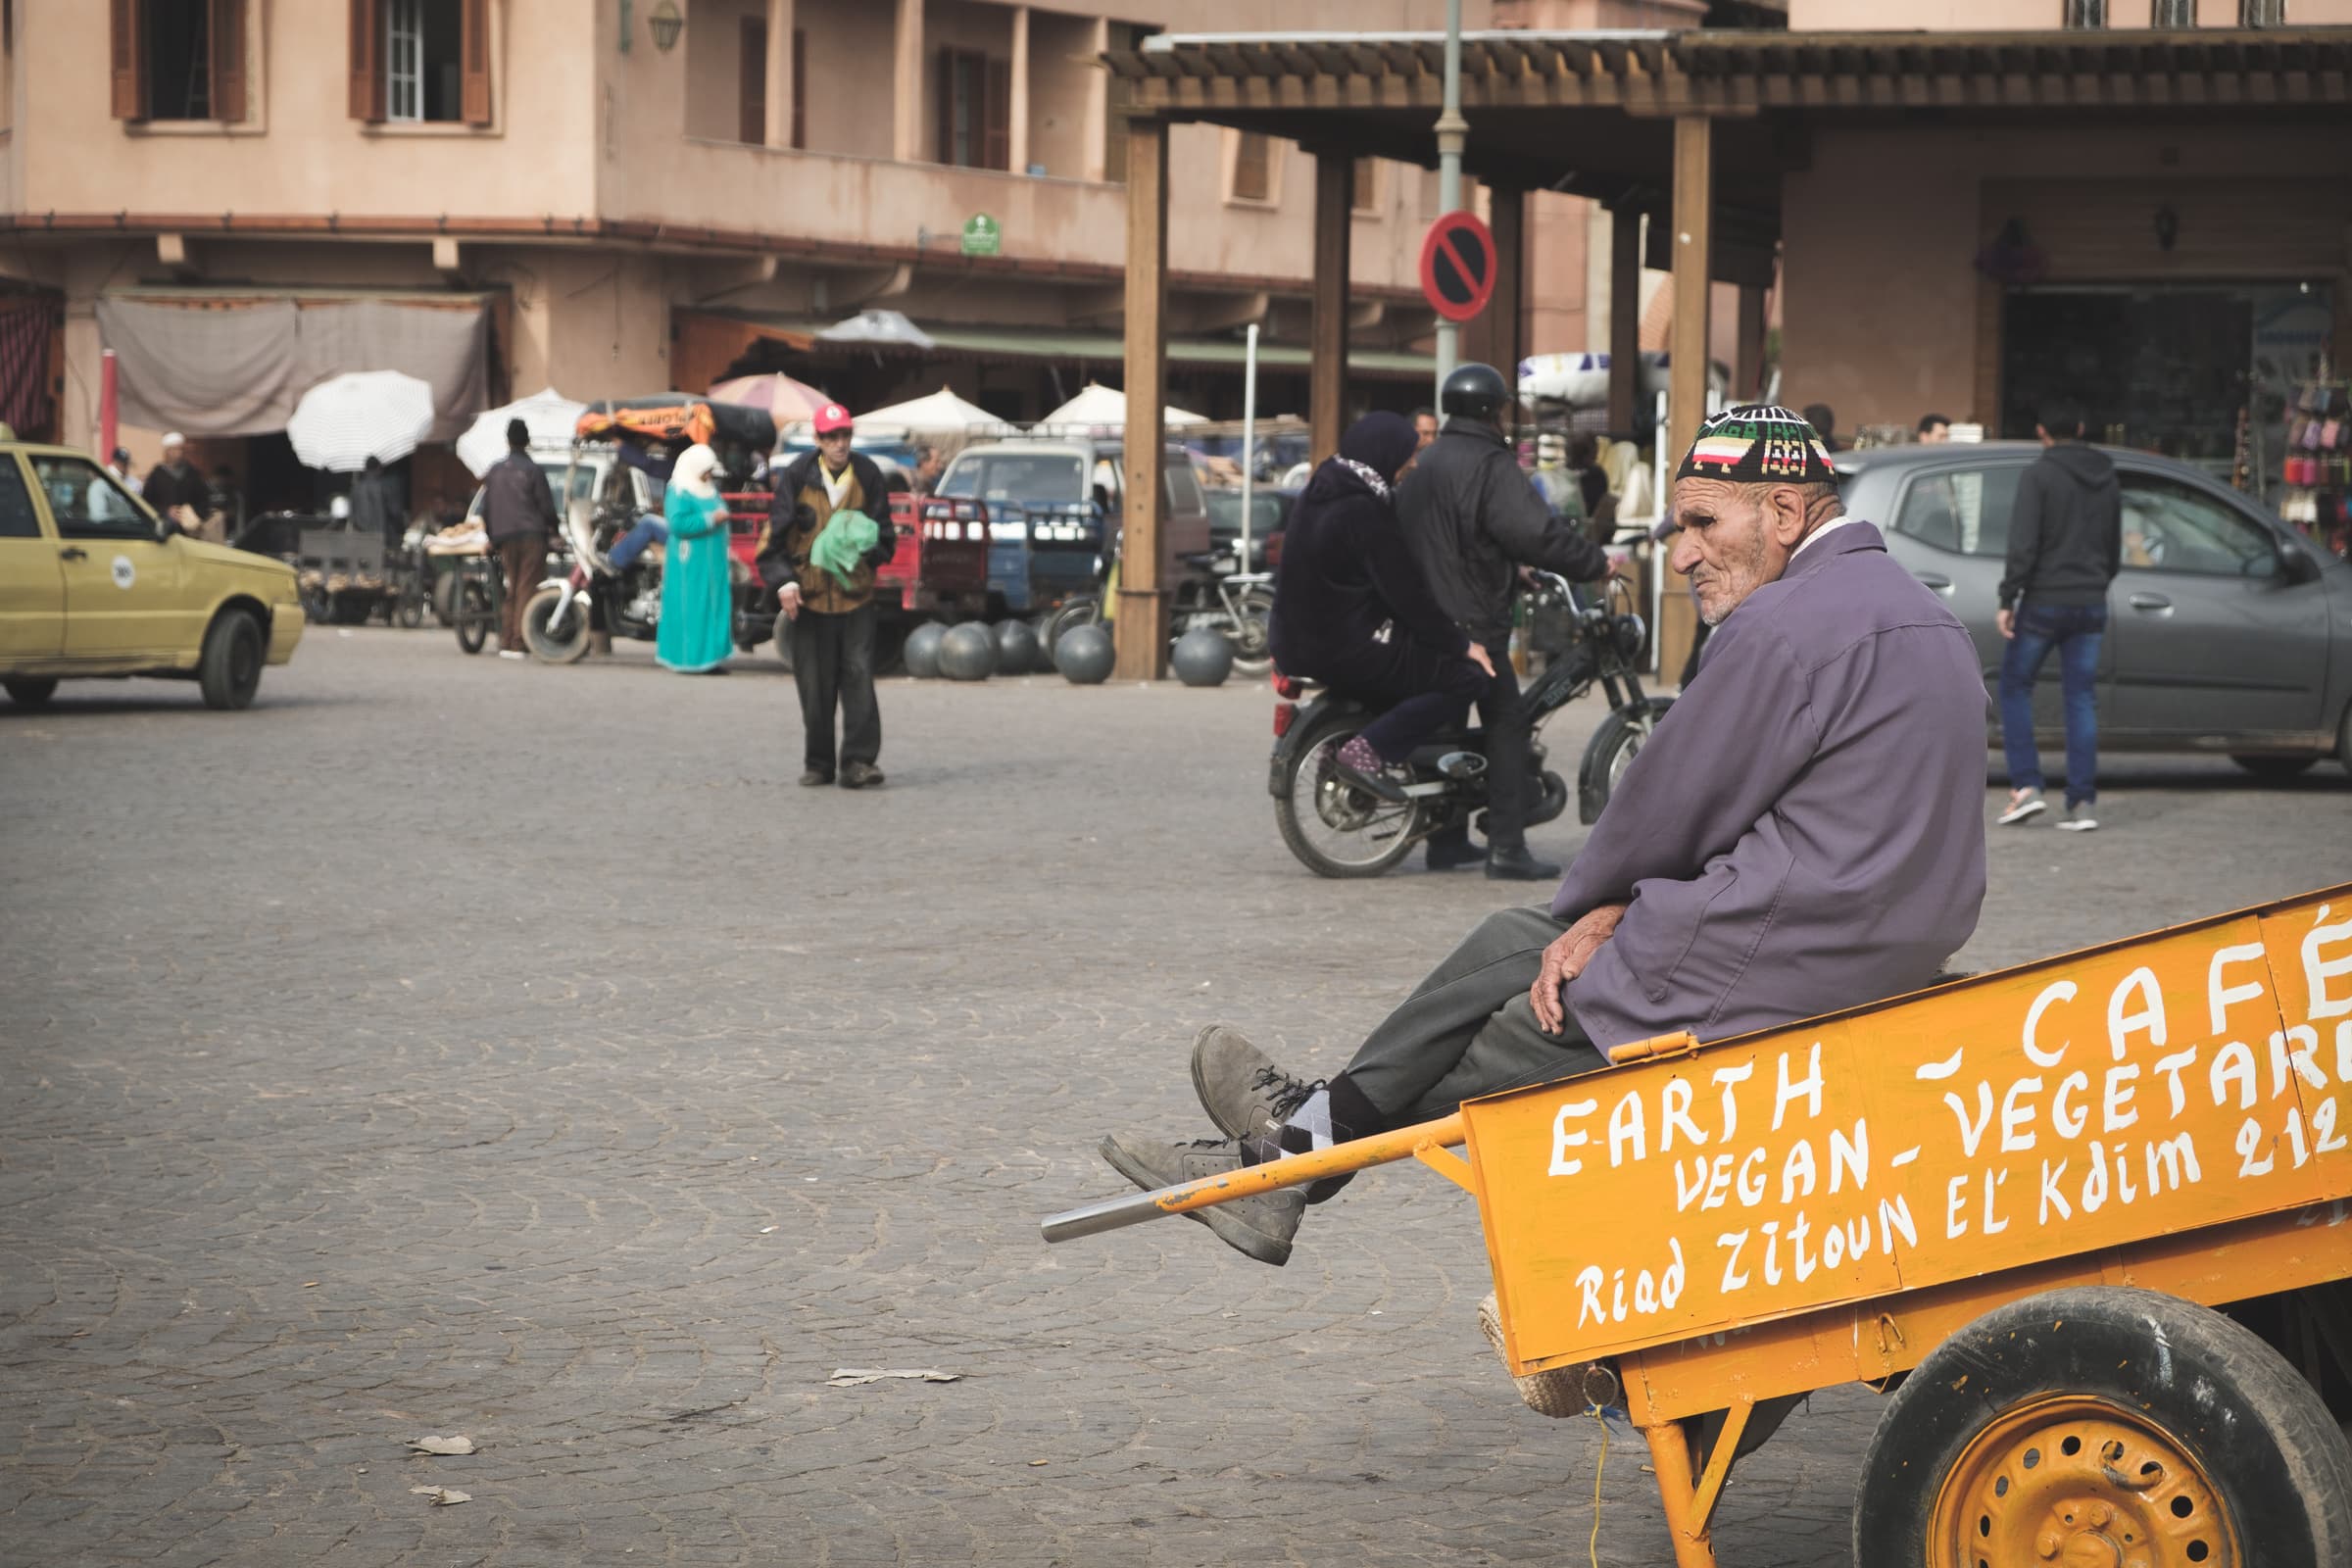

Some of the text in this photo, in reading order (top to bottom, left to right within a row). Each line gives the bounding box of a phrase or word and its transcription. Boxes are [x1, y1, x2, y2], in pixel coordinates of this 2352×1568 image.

[1547, 1042, 1826, 1177] EARTH
[2022, 904, 2352, 1068] CAFÉ
[1574, 1237, 1686, 1330] Riad
[2234, 1097, 2348, 1179] 212
